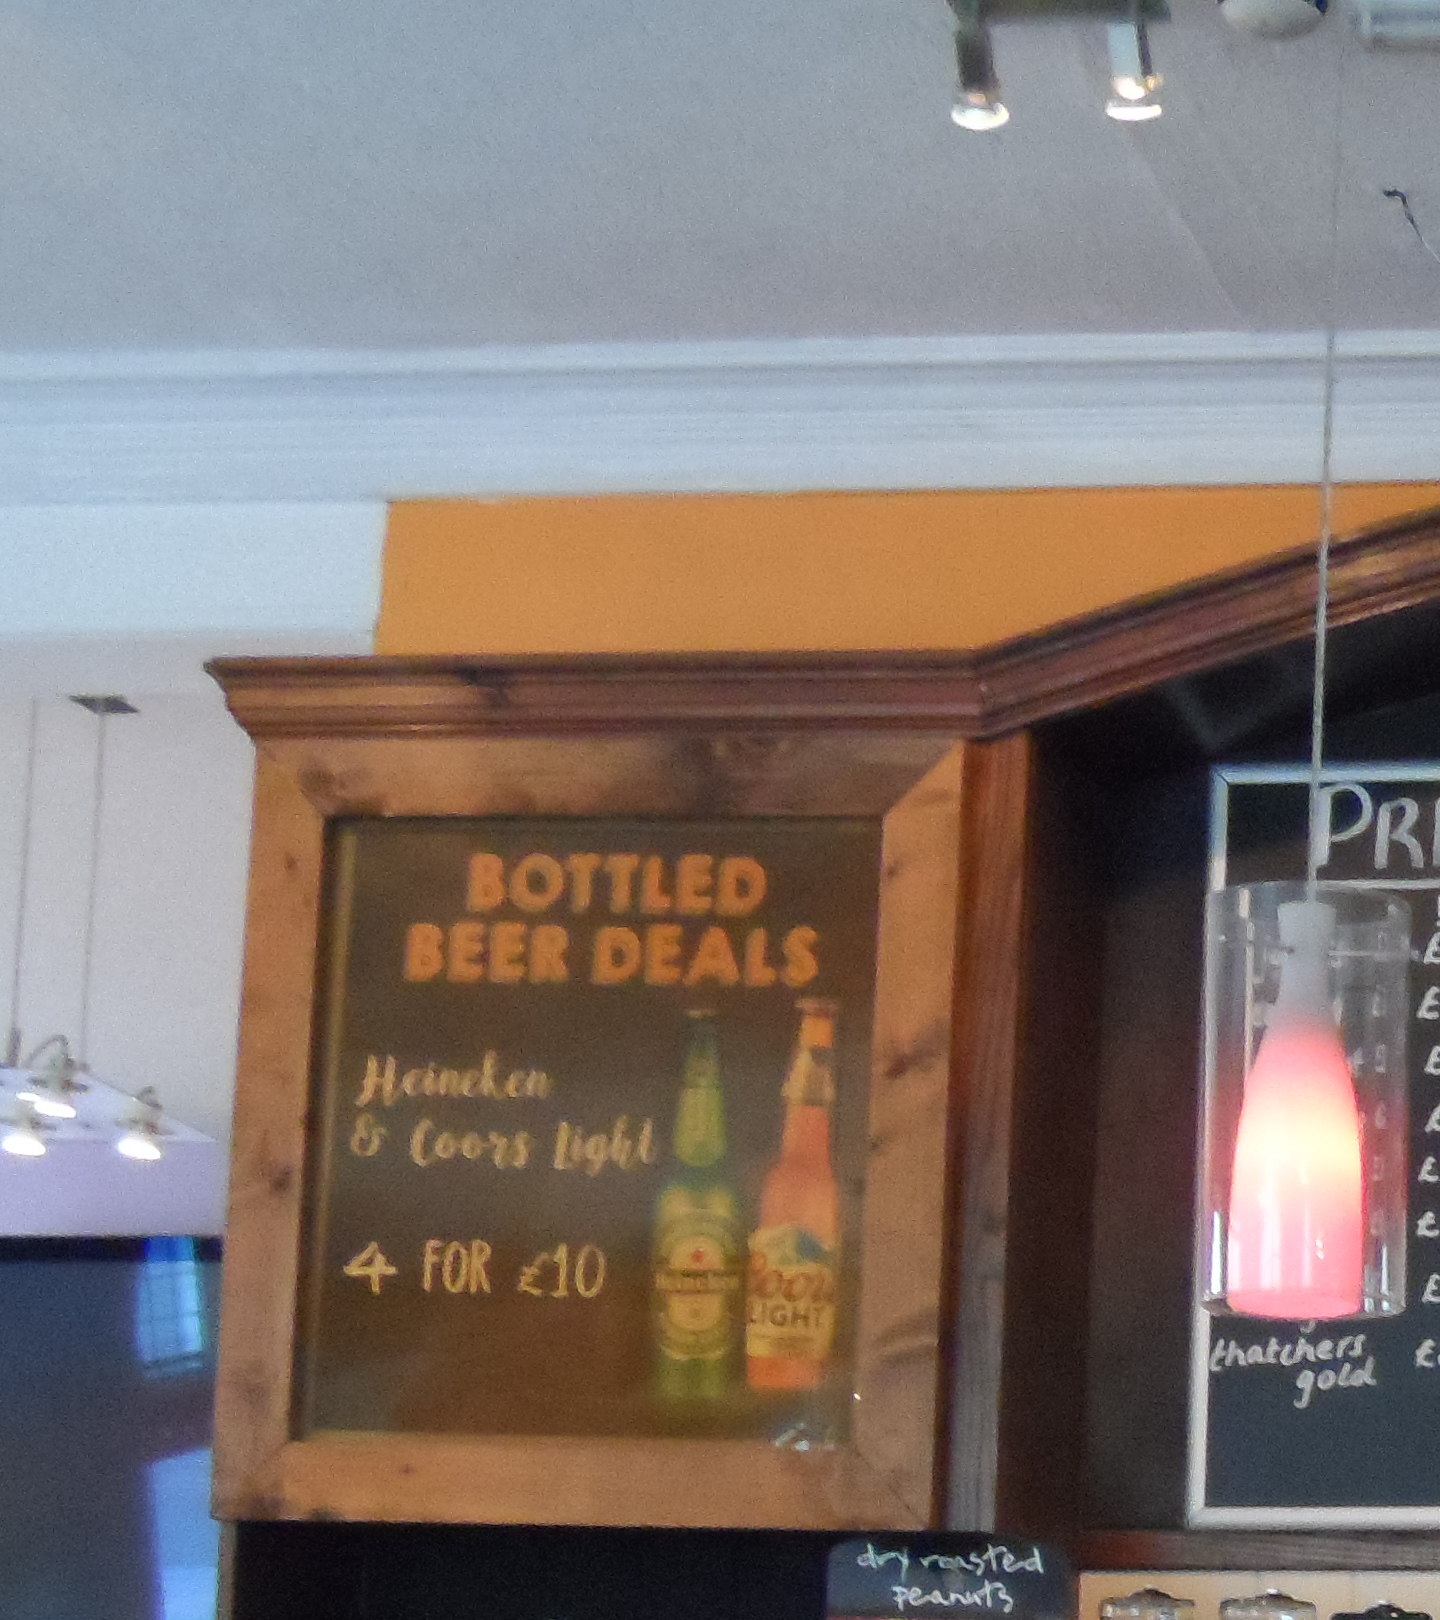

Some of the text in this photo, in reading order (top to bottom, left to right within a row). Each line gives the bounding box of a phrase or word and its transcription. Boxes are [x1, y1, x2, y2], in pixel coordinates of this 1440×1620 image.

[466, 852, 768, 917] BOTTLED
[405, 922, 819, 988] BEER DEALS
[355, 1050, 552, 1107] Heineken
[350, 1114, 660, 1177] & Coors Light
[343, 1239, 607, 1299] 4 FOR £10
[1210, 1334, 1367, 1372] thatchers
[1293, 1359, 1377, 1409] gold
[857, 1543, 1044, 1575] dry roasted
[892, 1580, 1014, 1614] peanuts
